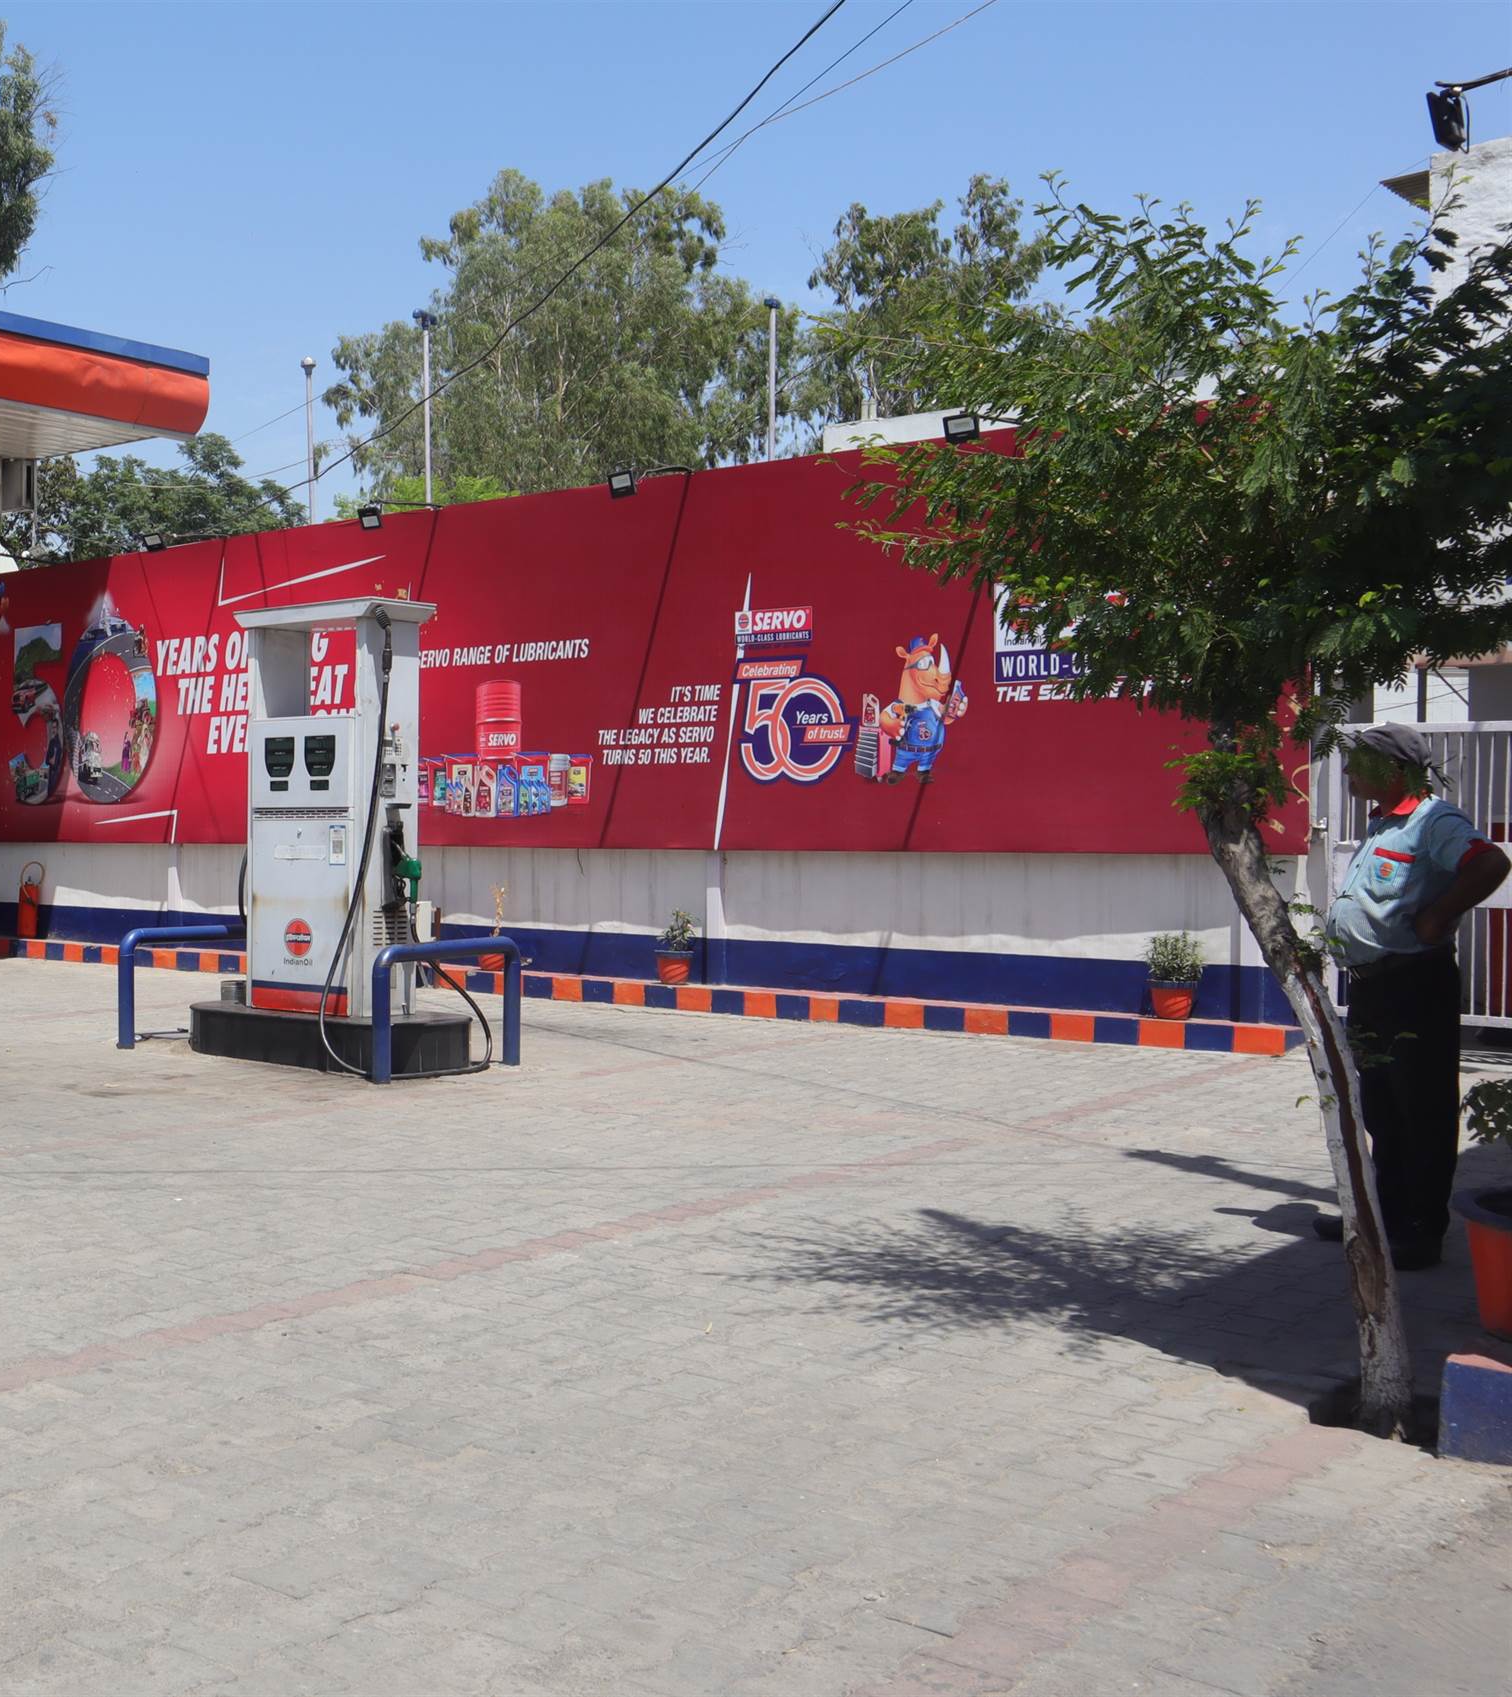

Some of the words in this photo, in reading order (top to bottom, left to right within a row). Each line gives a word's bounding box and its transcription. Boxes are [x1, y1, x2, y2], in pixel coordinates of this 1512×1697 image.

[753, 609, 807, 631] SERVO
[736, 632, 774, 643] WORLD-CLASS
[775, 631, 810, 641] LUBRICANTS
[156, 634, 220, 677] YEARS
[452, 646, 491, 667] RANGE
[494, 644, 511, 664] OF
[512, 638, 589, 663] LUBRICANTS
[742, 663, 797, 678] Celebrating
[177, 676, 215, 716] THE
[670, 685, 692, 703] IT'S
[694, 684, 722, 701] TIME
[996, 685, 1033, 703] THE
[638, 708, 655, 724] WE
[657, 705, 719, 723] CELEBRATE
[795, 711, 829, 724] Years
[598, 729, 617, 746] THE
[619, 728, 660, 745] LEGACY
[661, 727, 677, 744] AS
[678, 726, 715, 743] SERVO
[741, 678, 844, 781] 50
[807, 728, 817, 740] of
[818, 727, 846, 740] trust.
[488, 733, 517, 746] SERVO
[602, 749, 636, 765] TURNS
[638, 749, 652, 765] 50
[654, 748, 678, 764] THIS
[680, 747, 711, 764] YEAR.
[284, 957, 313, 967] IndianOil
